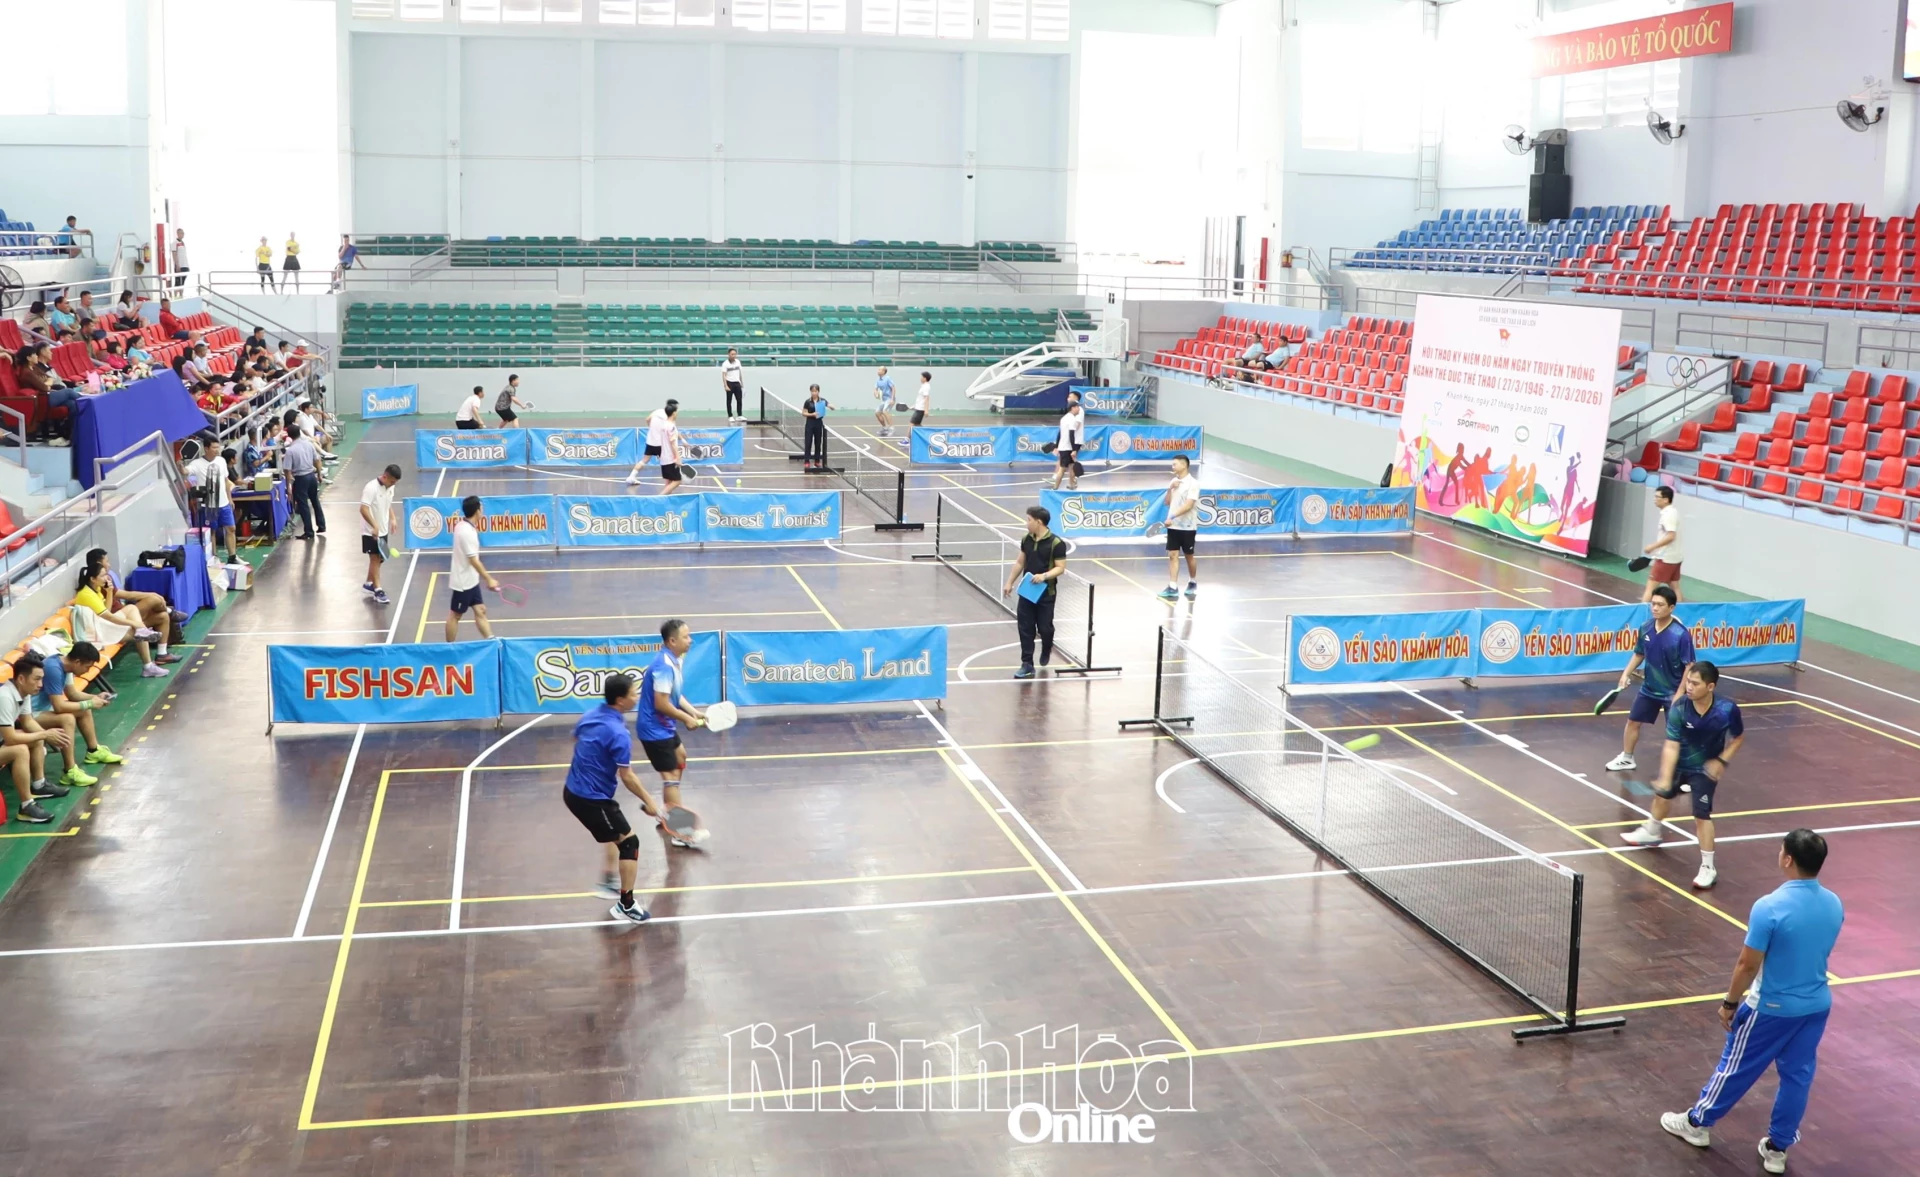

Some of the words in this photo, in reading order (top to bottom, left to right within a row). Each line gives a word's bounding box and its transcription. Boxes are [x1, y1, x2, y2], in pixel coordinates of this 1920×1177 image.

[1565, 38, 1582, 65] VÀ
[1586, 32, 1616, 63] BẢO
[1620, 27, 1640, 62] VỆ
[1644, 18, 1666, 53] TỔ
[1670, 10, 1721, 54] QUỐC
[1481, 354, 1492, 368] 80
[1490, 398, 1498, 406] 27
[1533, 405, 1548, 416] 2026
[1502, 378, 1544, 396] 27/3/1946
[1550, 385, 1603, 406] 27/3/2026)
[436, 434, 507, 462] Sanna
[546, 433, 616, 460] Sanest
[928, 432, 995, 459] Sanna
[490, 508, 524, 533] KHÁNH
[526, 508, 547, 531] HÒA
[568, 502, 684, 537] Sanatech
[705, 504, 764, 529] Sanest
[767, 503, 829, 528] Tourist
[1061, 496, 1146, 531] Sanest
[1197, 495, 1274, 527] Sanna
[616, 641, 651, 654] KHÁNH
[1344, 631, 1371, 664] YẾN
[1372, 634, 1398, 664] SÀO
[1401, 632, 1443, 662] KHÁNH
[1444, 629, 1470, 659] HÒA
[1523, 624, 1547, 657] YẾN
[1548, 628, 1572, 657] SÀO
[1574, 626, 1614, 656] KHÁNH
[1614, 623, 1639, 652] HÒA
[1711, 621, 1735, 649] SÀO
[1736, 620, 1773, 648] KHÁNH
[1773, 617, 1797, 645] HÒA
[742, 650, 856, 685] Sanatech
[862, 647, 931, 681] Land
[304, 663, 475, 700] FISHSAN
